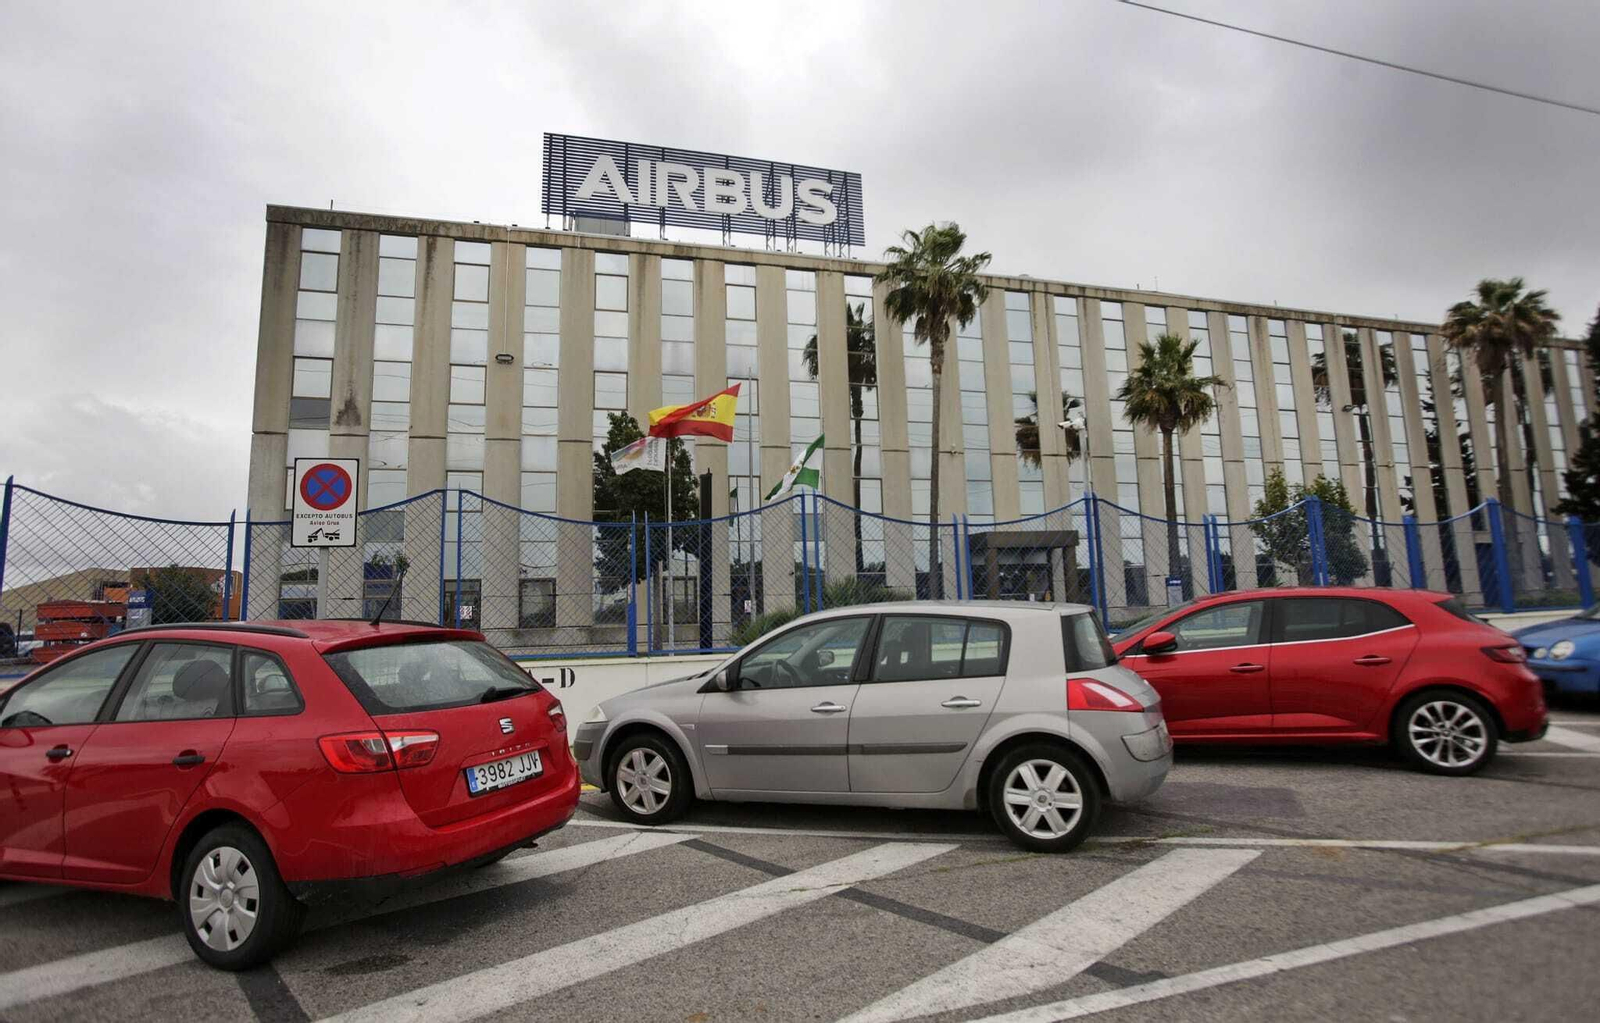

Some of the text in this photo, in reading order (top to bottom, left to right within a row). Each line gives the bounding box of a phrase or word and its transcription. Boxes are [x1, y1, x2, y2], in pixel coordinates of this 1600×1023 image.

[574, 154, 838, 226] AIRBUS
[478, 760, 514, 785] 3982
[519, 752, 538, 774] JJV
